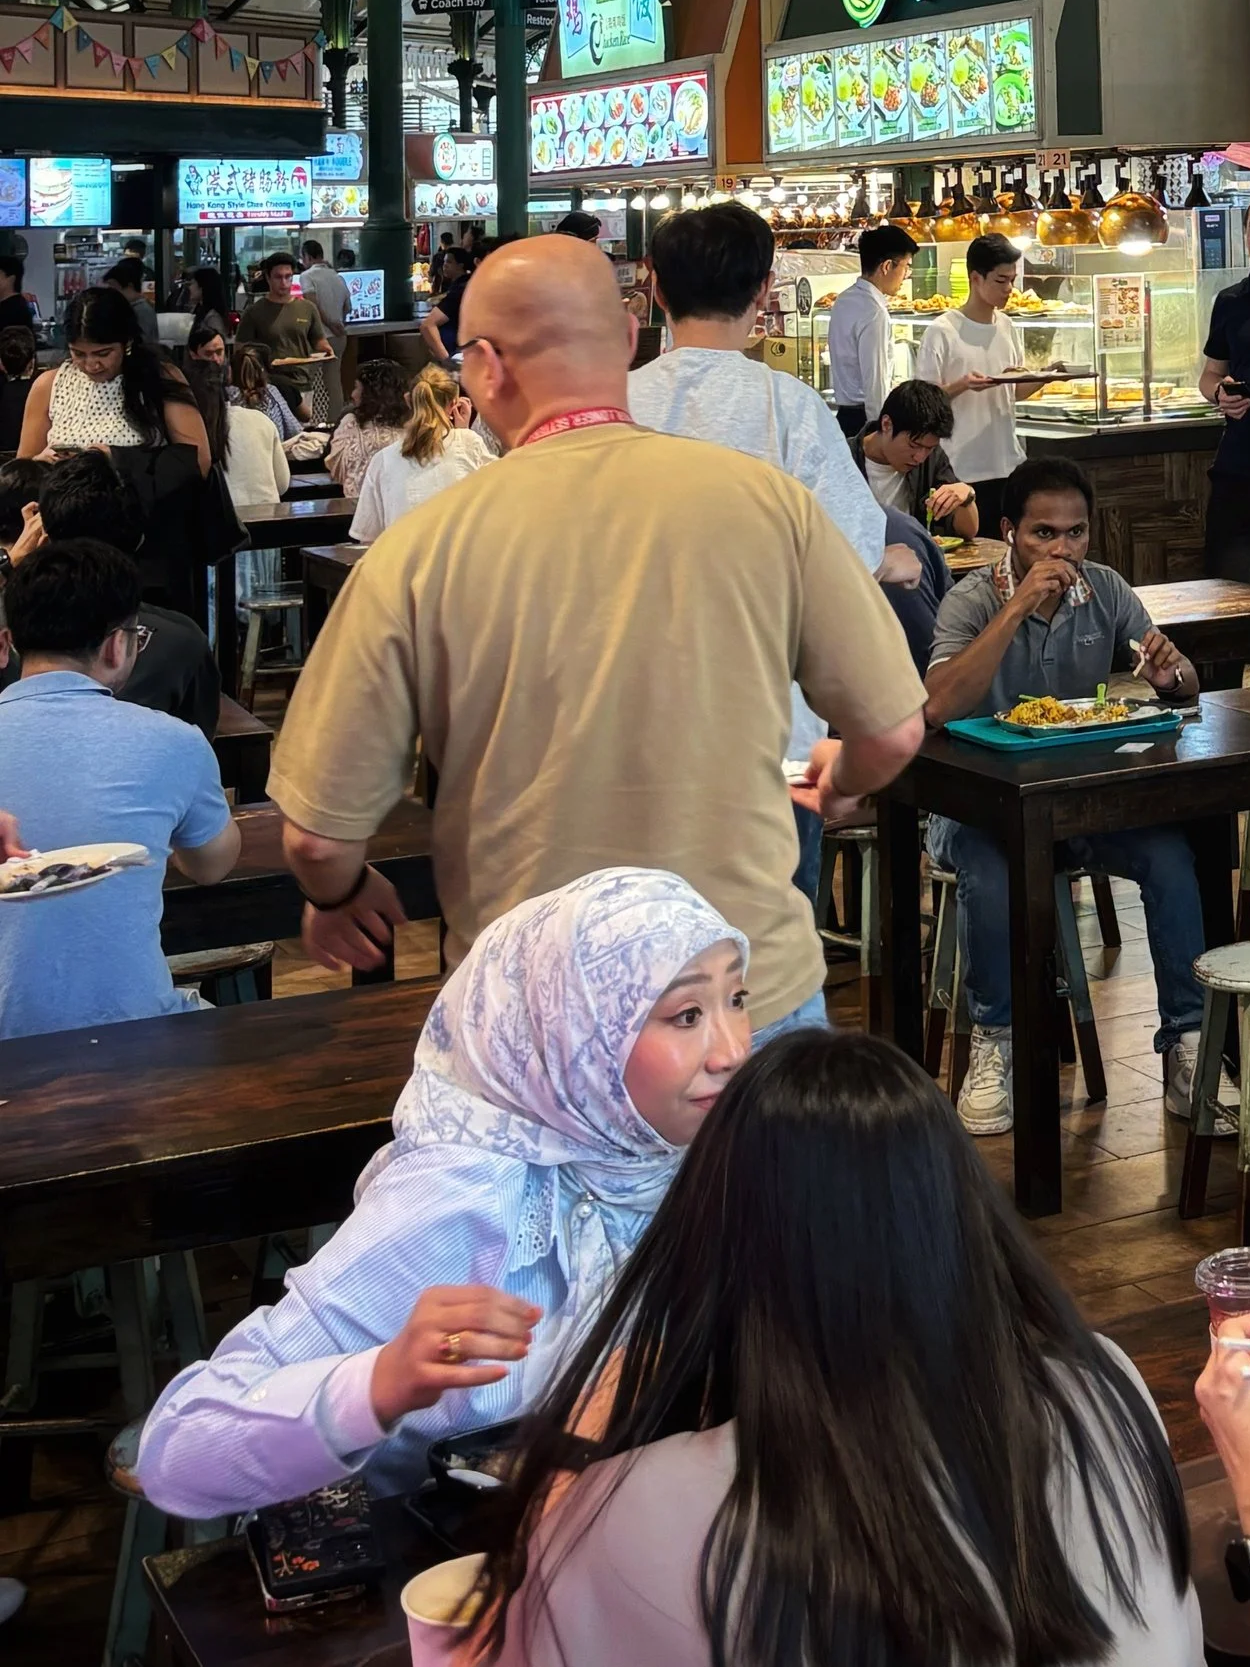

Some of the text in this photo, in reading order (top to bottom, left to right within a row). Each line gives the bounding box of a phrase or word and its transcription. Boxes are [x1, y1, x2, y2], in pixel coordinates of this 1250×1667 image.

[1053, 152, 1067, 166] 21
[721, 177, 734, 189] 19
[227, 200, 246, 210] Style
